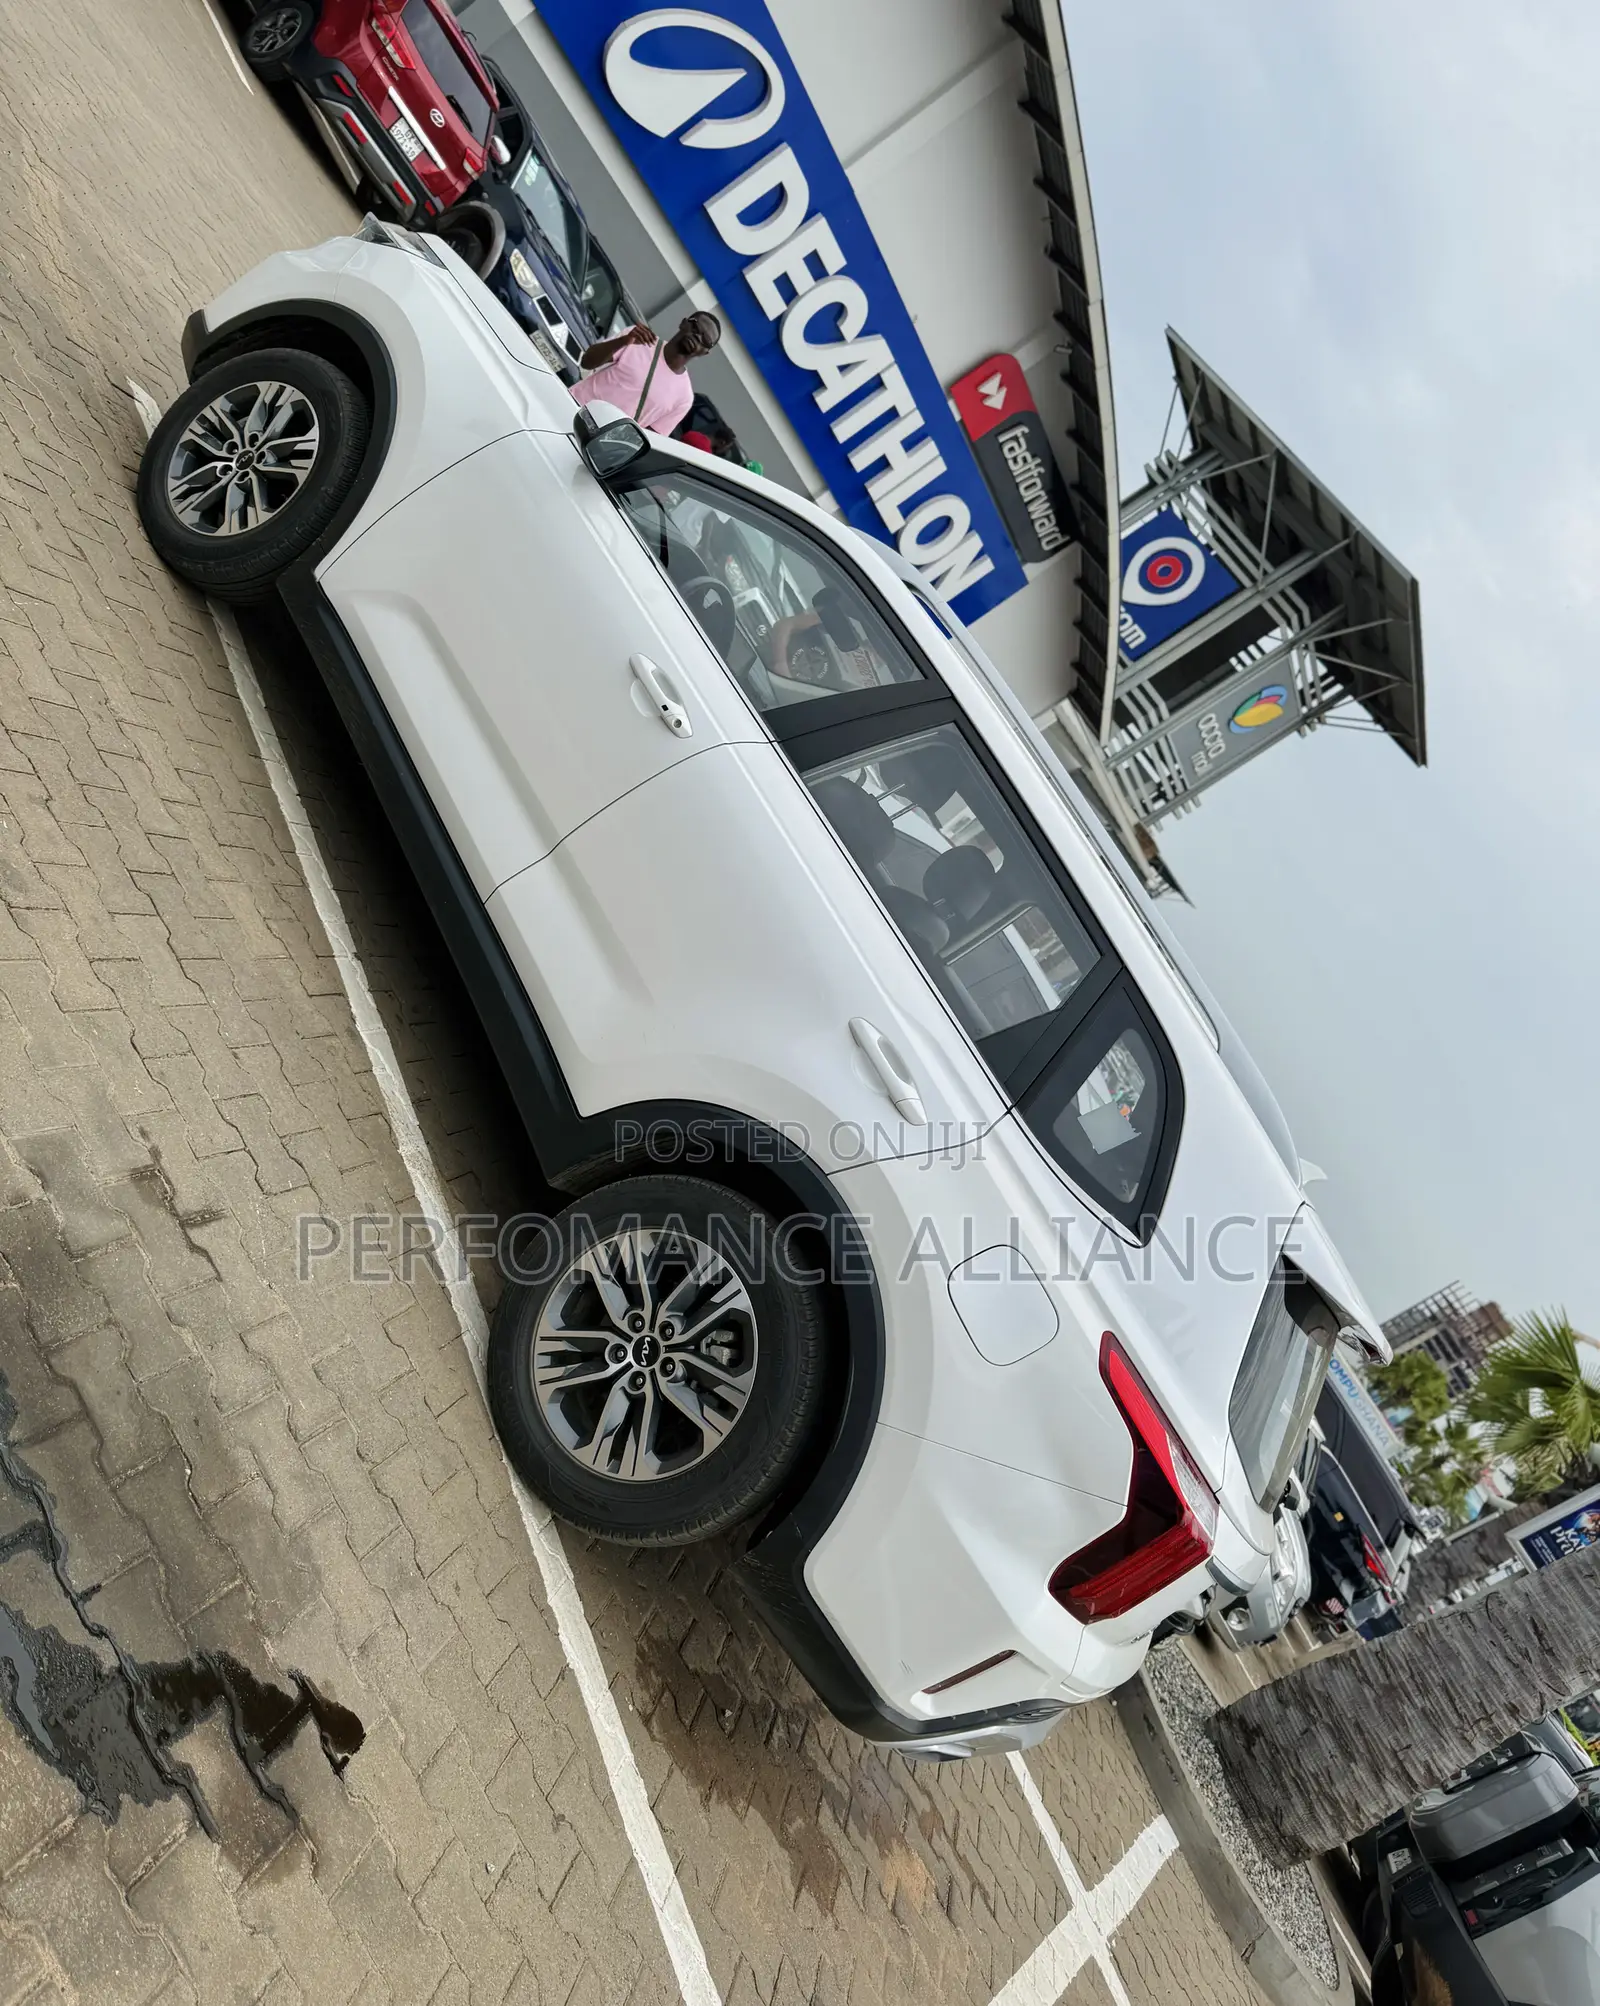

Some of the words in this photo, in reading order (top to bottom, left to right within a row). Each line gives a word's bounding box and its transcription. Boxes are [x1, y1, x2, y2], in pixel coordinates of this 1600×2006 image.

[703, 142, 995, 603] DECATHLON
[999, 423, 1069, 551] fastforward
[1120, 605, 1147, 649] om
[1198, 712, 1226, 760] accra
[1329, 1352, 1388, 1447] OMPUGHANA
